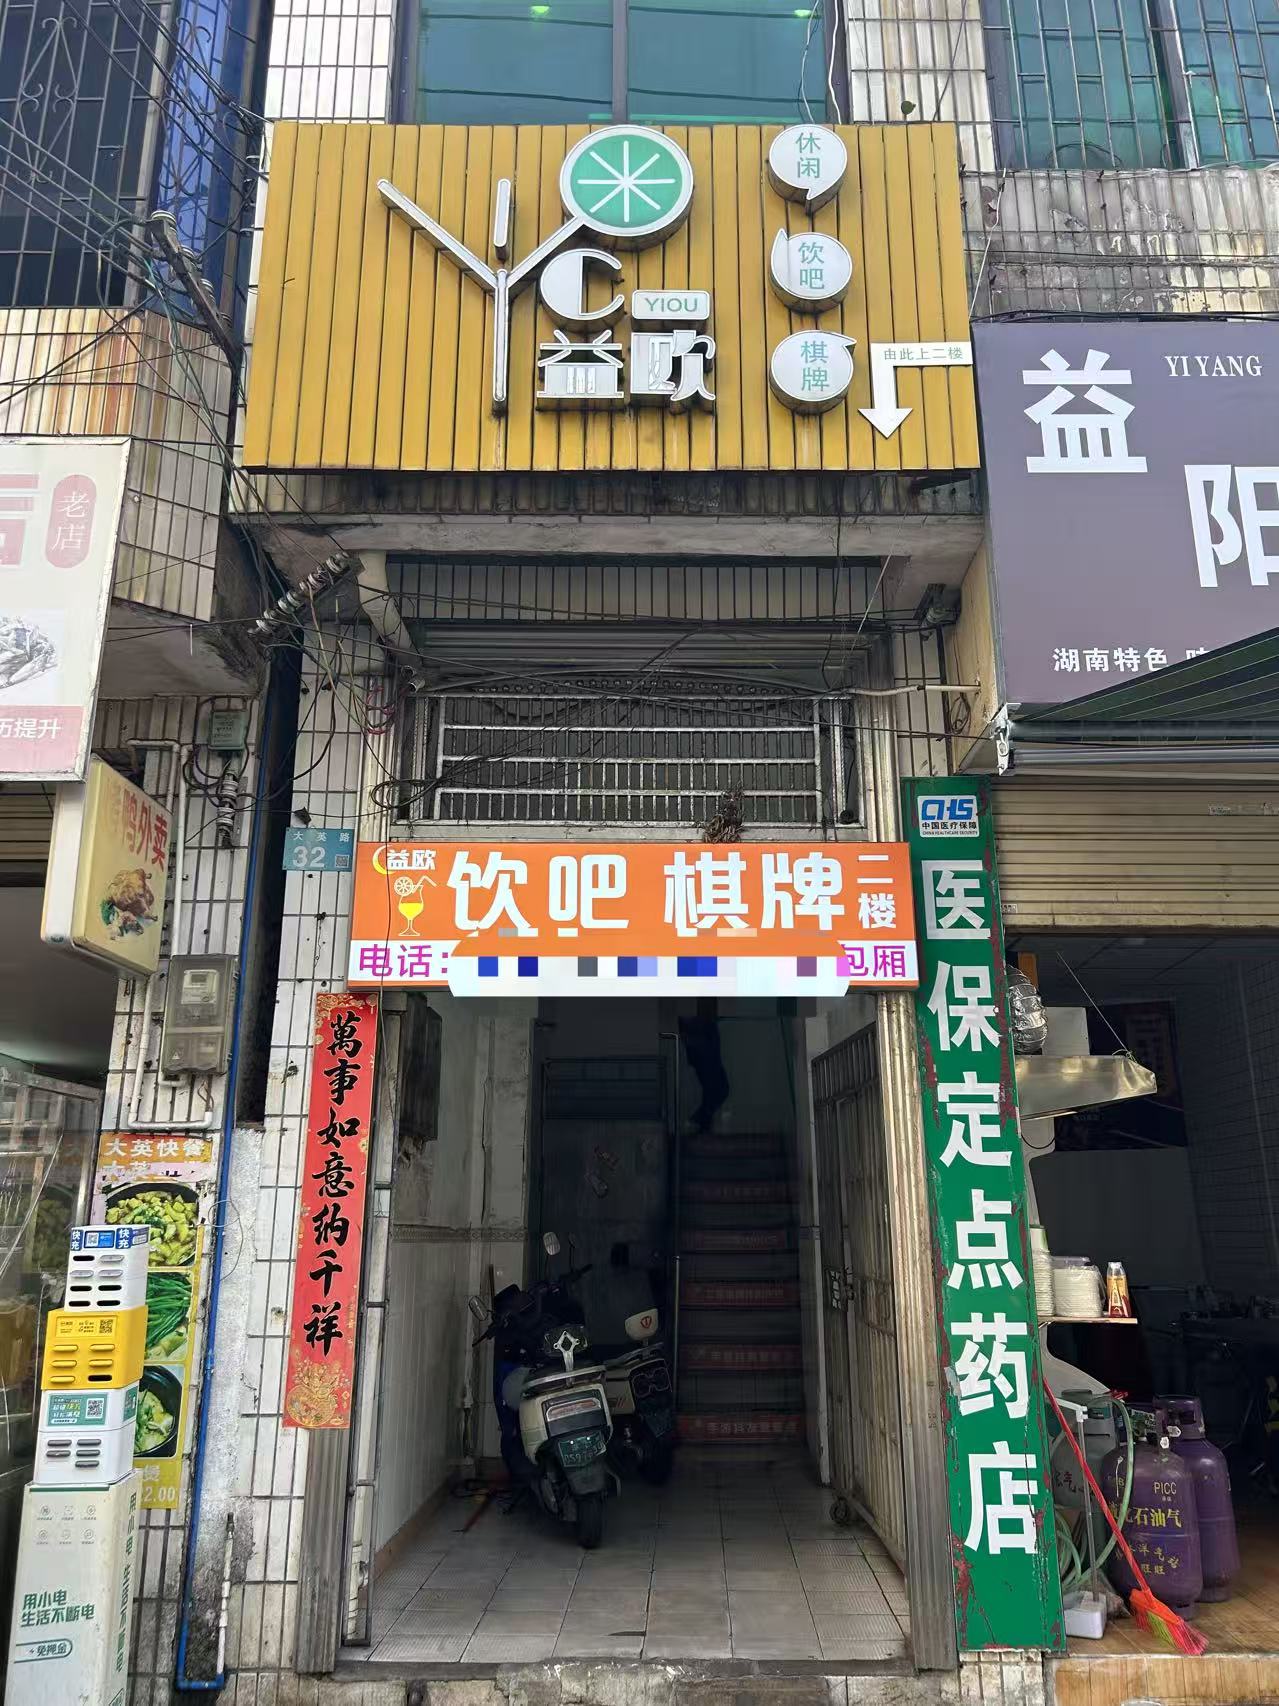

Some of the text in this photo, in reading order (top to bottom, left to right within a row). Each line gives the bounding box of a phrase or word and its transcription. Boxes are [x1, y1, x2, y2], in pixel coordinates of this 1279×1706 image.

[795, 131, 822, 179] 休闲
[798, 241, 825, 290] 饮吧
[644, 297, 699, 314] YIOU
[536, 329, 717, 402] 益欧
[883, 347, 964, 361] 由此上二楼
[800, 340, 830, 393] 棋牌
[1022, 348, 1149, 473] 益
[51, 490, 89, 551] 老店
[1052, 647, 1169, 673] 湖南特色
[293, 831, 350, 843] 大英路
[921, 821, 977, 830] 中国医疗保障
[292, 845, 326, 868] 32
[387, 849, 437, 871] 益欧
[446, 850, 846, 938] 饮吧 棋牌
[856, 854, 897, 929] 二楼
[840, 943, 907, 978] 包厢
[103, 1137, 204, 1158] 大英快餐
[920, 859, 1039, 1556] 医保定点药店
[71, 1230, 81, 1250] 快充
[118, 1228, 130, 1249] 快充
[1153, 1481, 1178, 1496] PICC
[22, 1588, 67, 1611] 用小电
[20, 1603, 95, 1628] 生活不断电
[36, 1642, 67, 1657] 免押金
